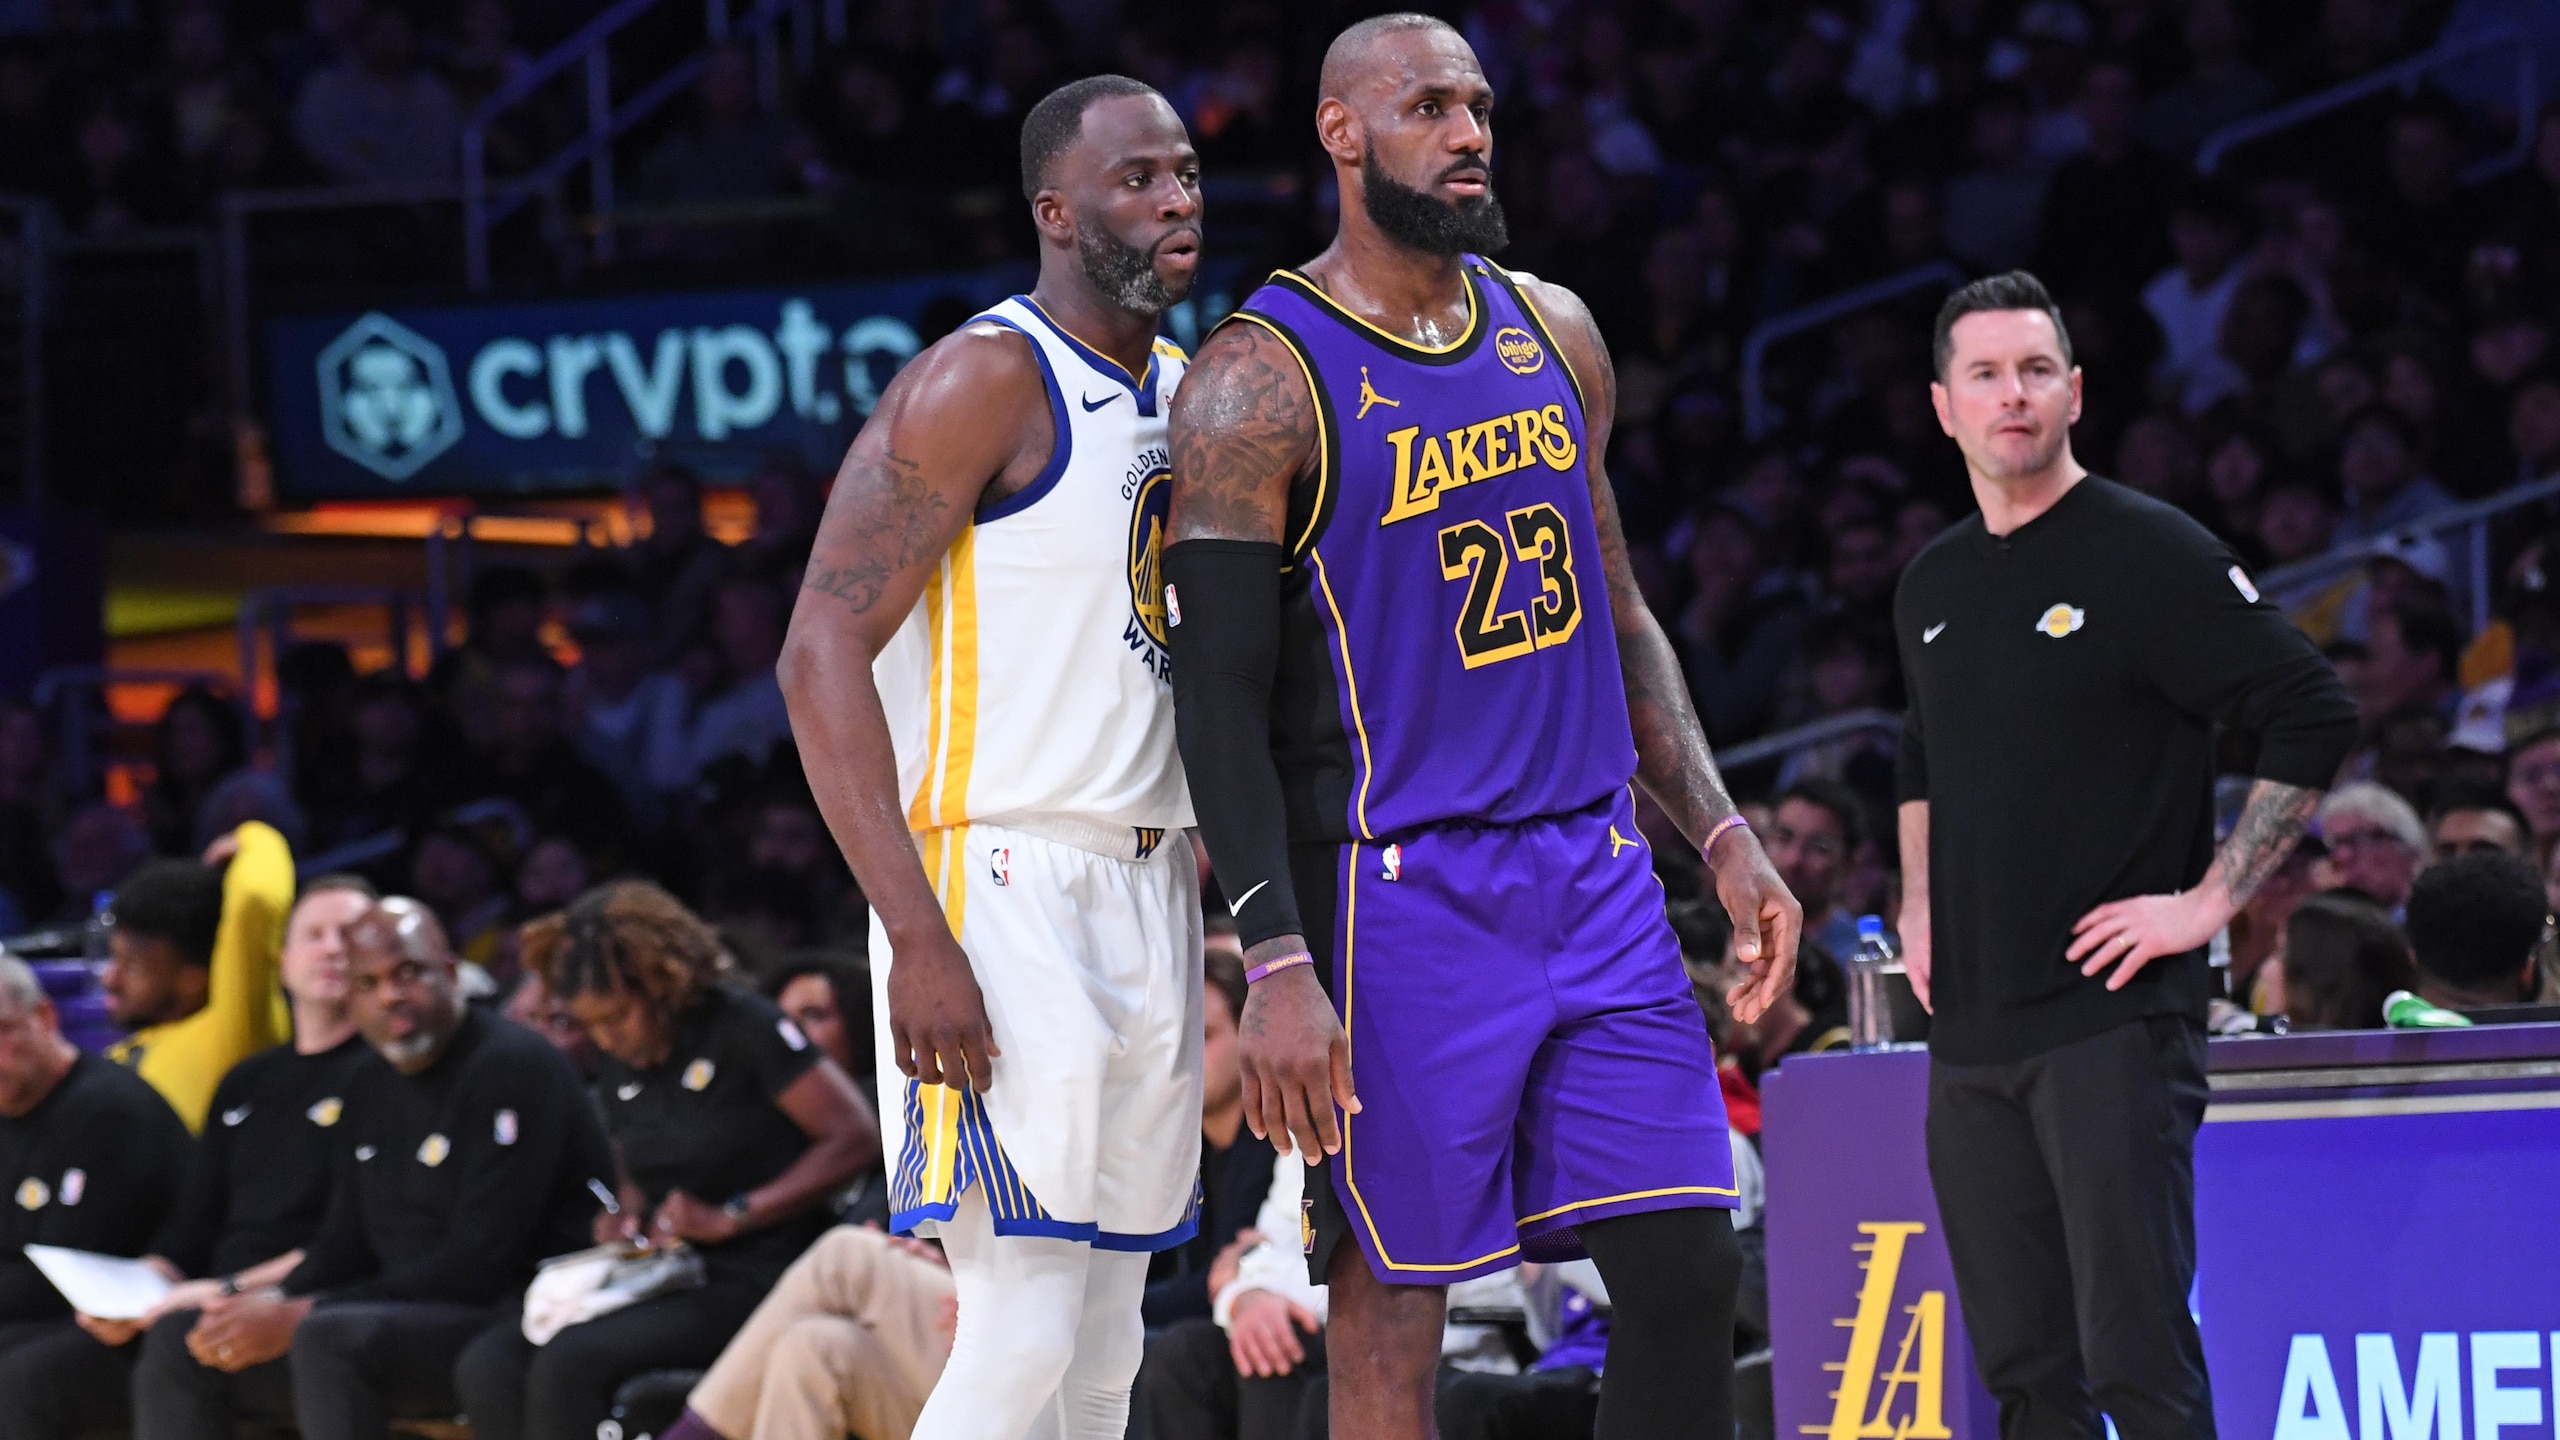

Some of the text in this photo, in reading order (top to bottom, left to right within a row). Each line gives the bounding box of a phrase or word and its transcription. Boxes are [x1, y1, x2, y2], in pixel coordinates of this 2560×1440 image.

[1499, 340, 1539, 359] bibigo
[1121, 448, 1169, 501] GOLDEN
[1379, 403, 1578, 527] LAKERS
[1438, 502, 1582, 670] 23
[2272, 1331, 2560, 1440] AME
